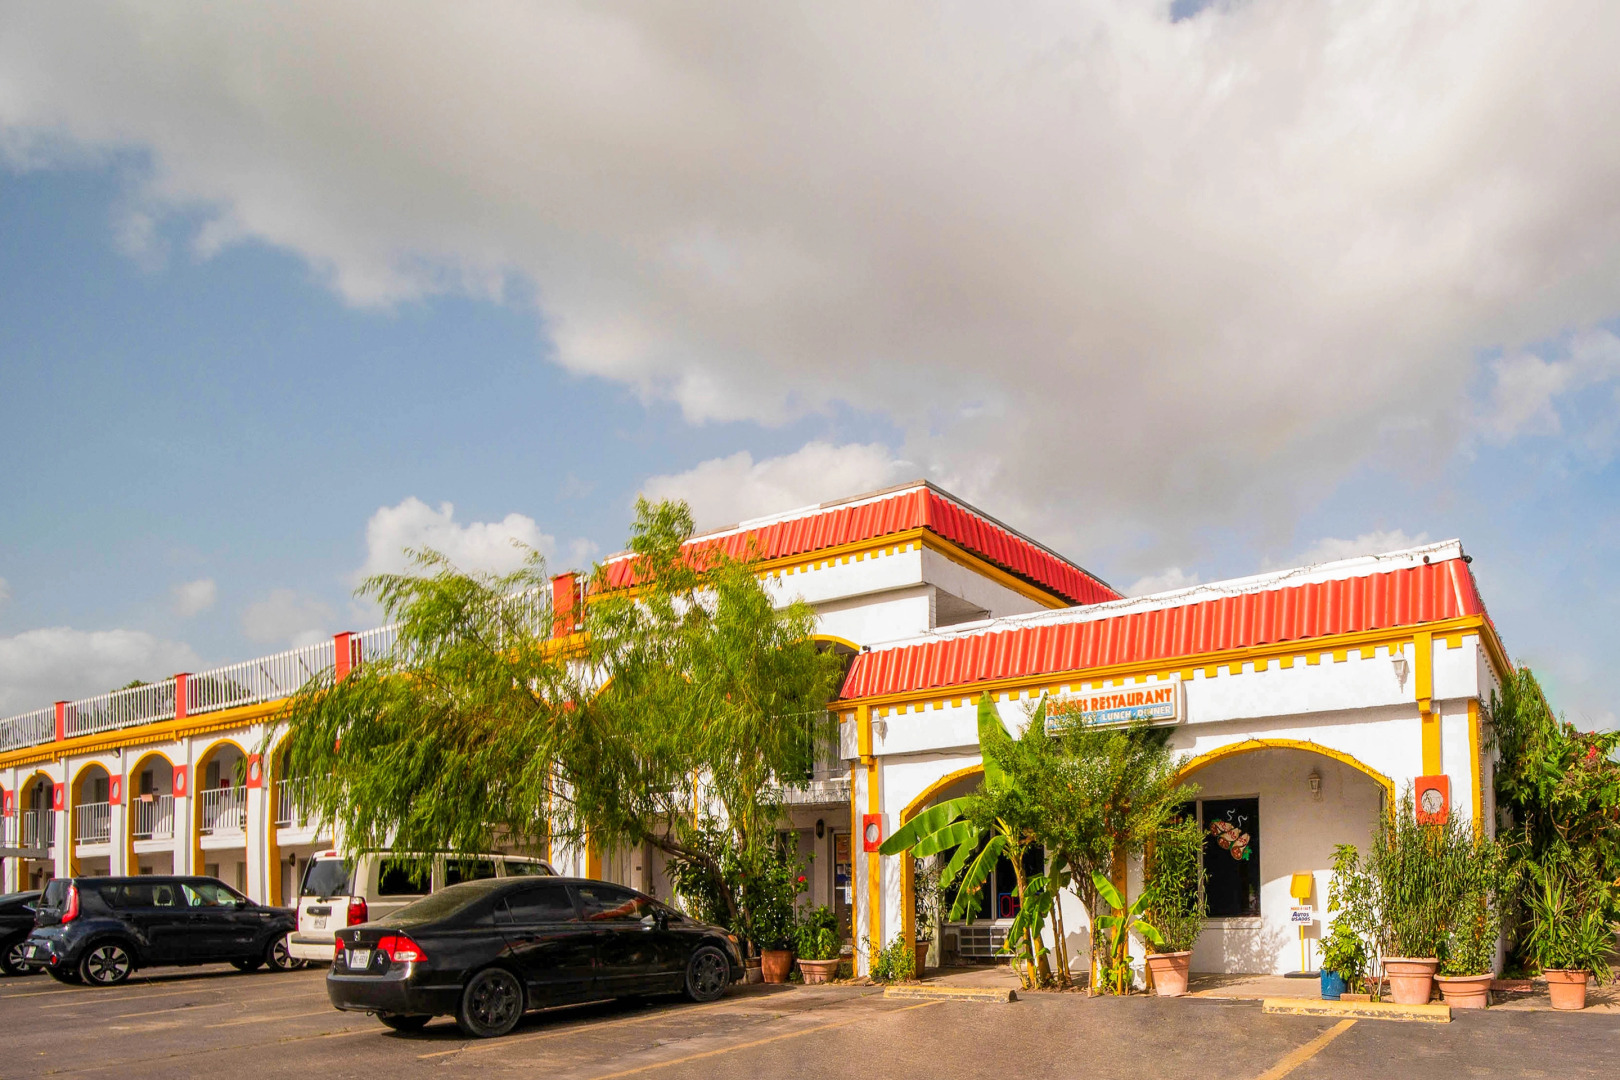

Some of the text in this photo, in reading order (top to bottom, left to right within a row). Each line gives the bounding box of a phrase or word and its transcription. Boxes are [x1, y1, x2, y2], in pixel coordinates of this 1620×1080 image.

[1091, 688, 1172, 711] RESTAURANT
[1102, 710, 1131, 721] LUNCH
[1137, 705, 1171, 716] DINNER
